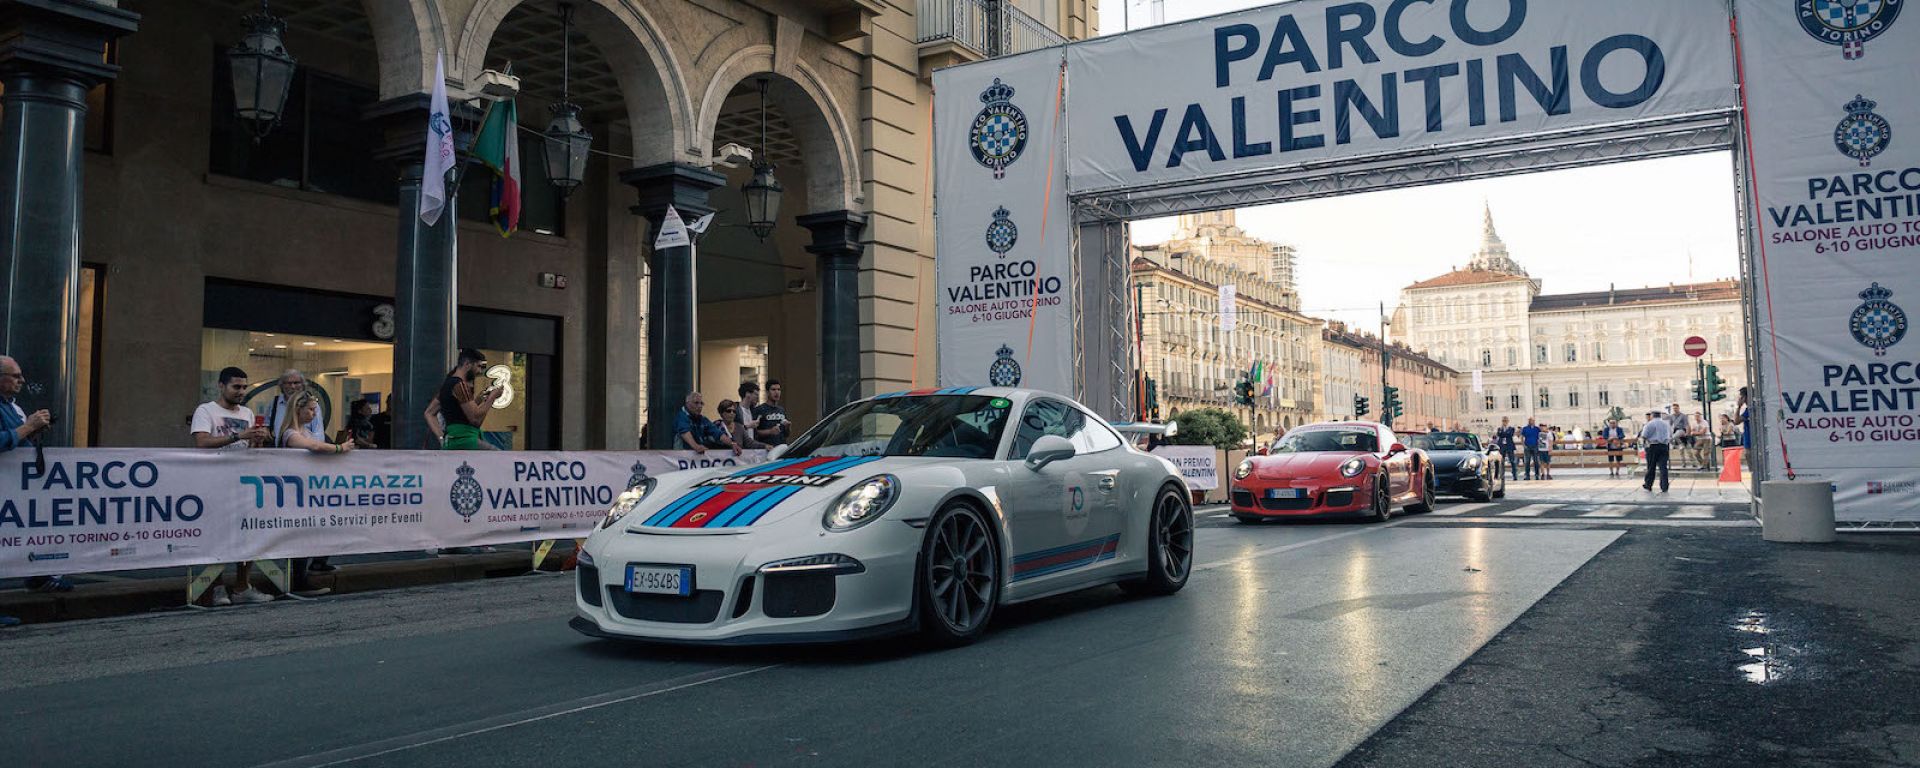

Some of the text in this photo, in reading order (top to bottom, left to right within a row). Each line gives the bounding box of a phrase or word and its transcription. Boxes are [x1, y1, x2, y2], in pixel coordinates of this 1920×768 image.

[1820, 21, 1883, 41] TORINO
[1214, 0, 1527, 89] PARCO
[1113, 33, 1666, 173] VALENTINO
[972, 107, 1026, 148] PARCO VALENTINO
[981, 150, 1017, 165] TORINO
[1808, 167, 1920, 200] PARCO
[1772, 227, 1842, 244] SALONE
[1849, 222, 1897, 238] AUTO
[1815, 240, 1850, 254] 6-10
[970, 260, 1036, 283] PARCO
[948, 276, 1061, 303] VALENTINO
[949, 296, 1061, 315] SALONE AUTO TORINO
[372, 303, 395, 340] 3
[972, 312, 991, 323] 6-10
[1823, 361, 1920, 387] PARC
[486, 364, 515, 409] 3
[1786, 414, 1913, 430] SALONE AUTO
[1829, 429, 1920, 443] 6-10 GIUG
[21, 460, 159, 490] PARCO
[514, 460, 587, 482] PARCO
[704, 475, 832, 486] MARTINI
[308, 475, 423, 490] MARAZZI
[309, 492, 423, 508] NOLEGGIO
[486, 485, 613, 510] VALENTINO
[240, 512, 422, 530] Allestimenti e Servizi per Eventi
[488, 509, 610, 523] SALONE AUTO TORINO 6-10 GIUGN
[26, 534, 65, 546] AUTO
[69, 532, 119, 544] TORINO
[122, 530, 149, 541] 6-10
[153, 528, 202, 539] GIUGNO
